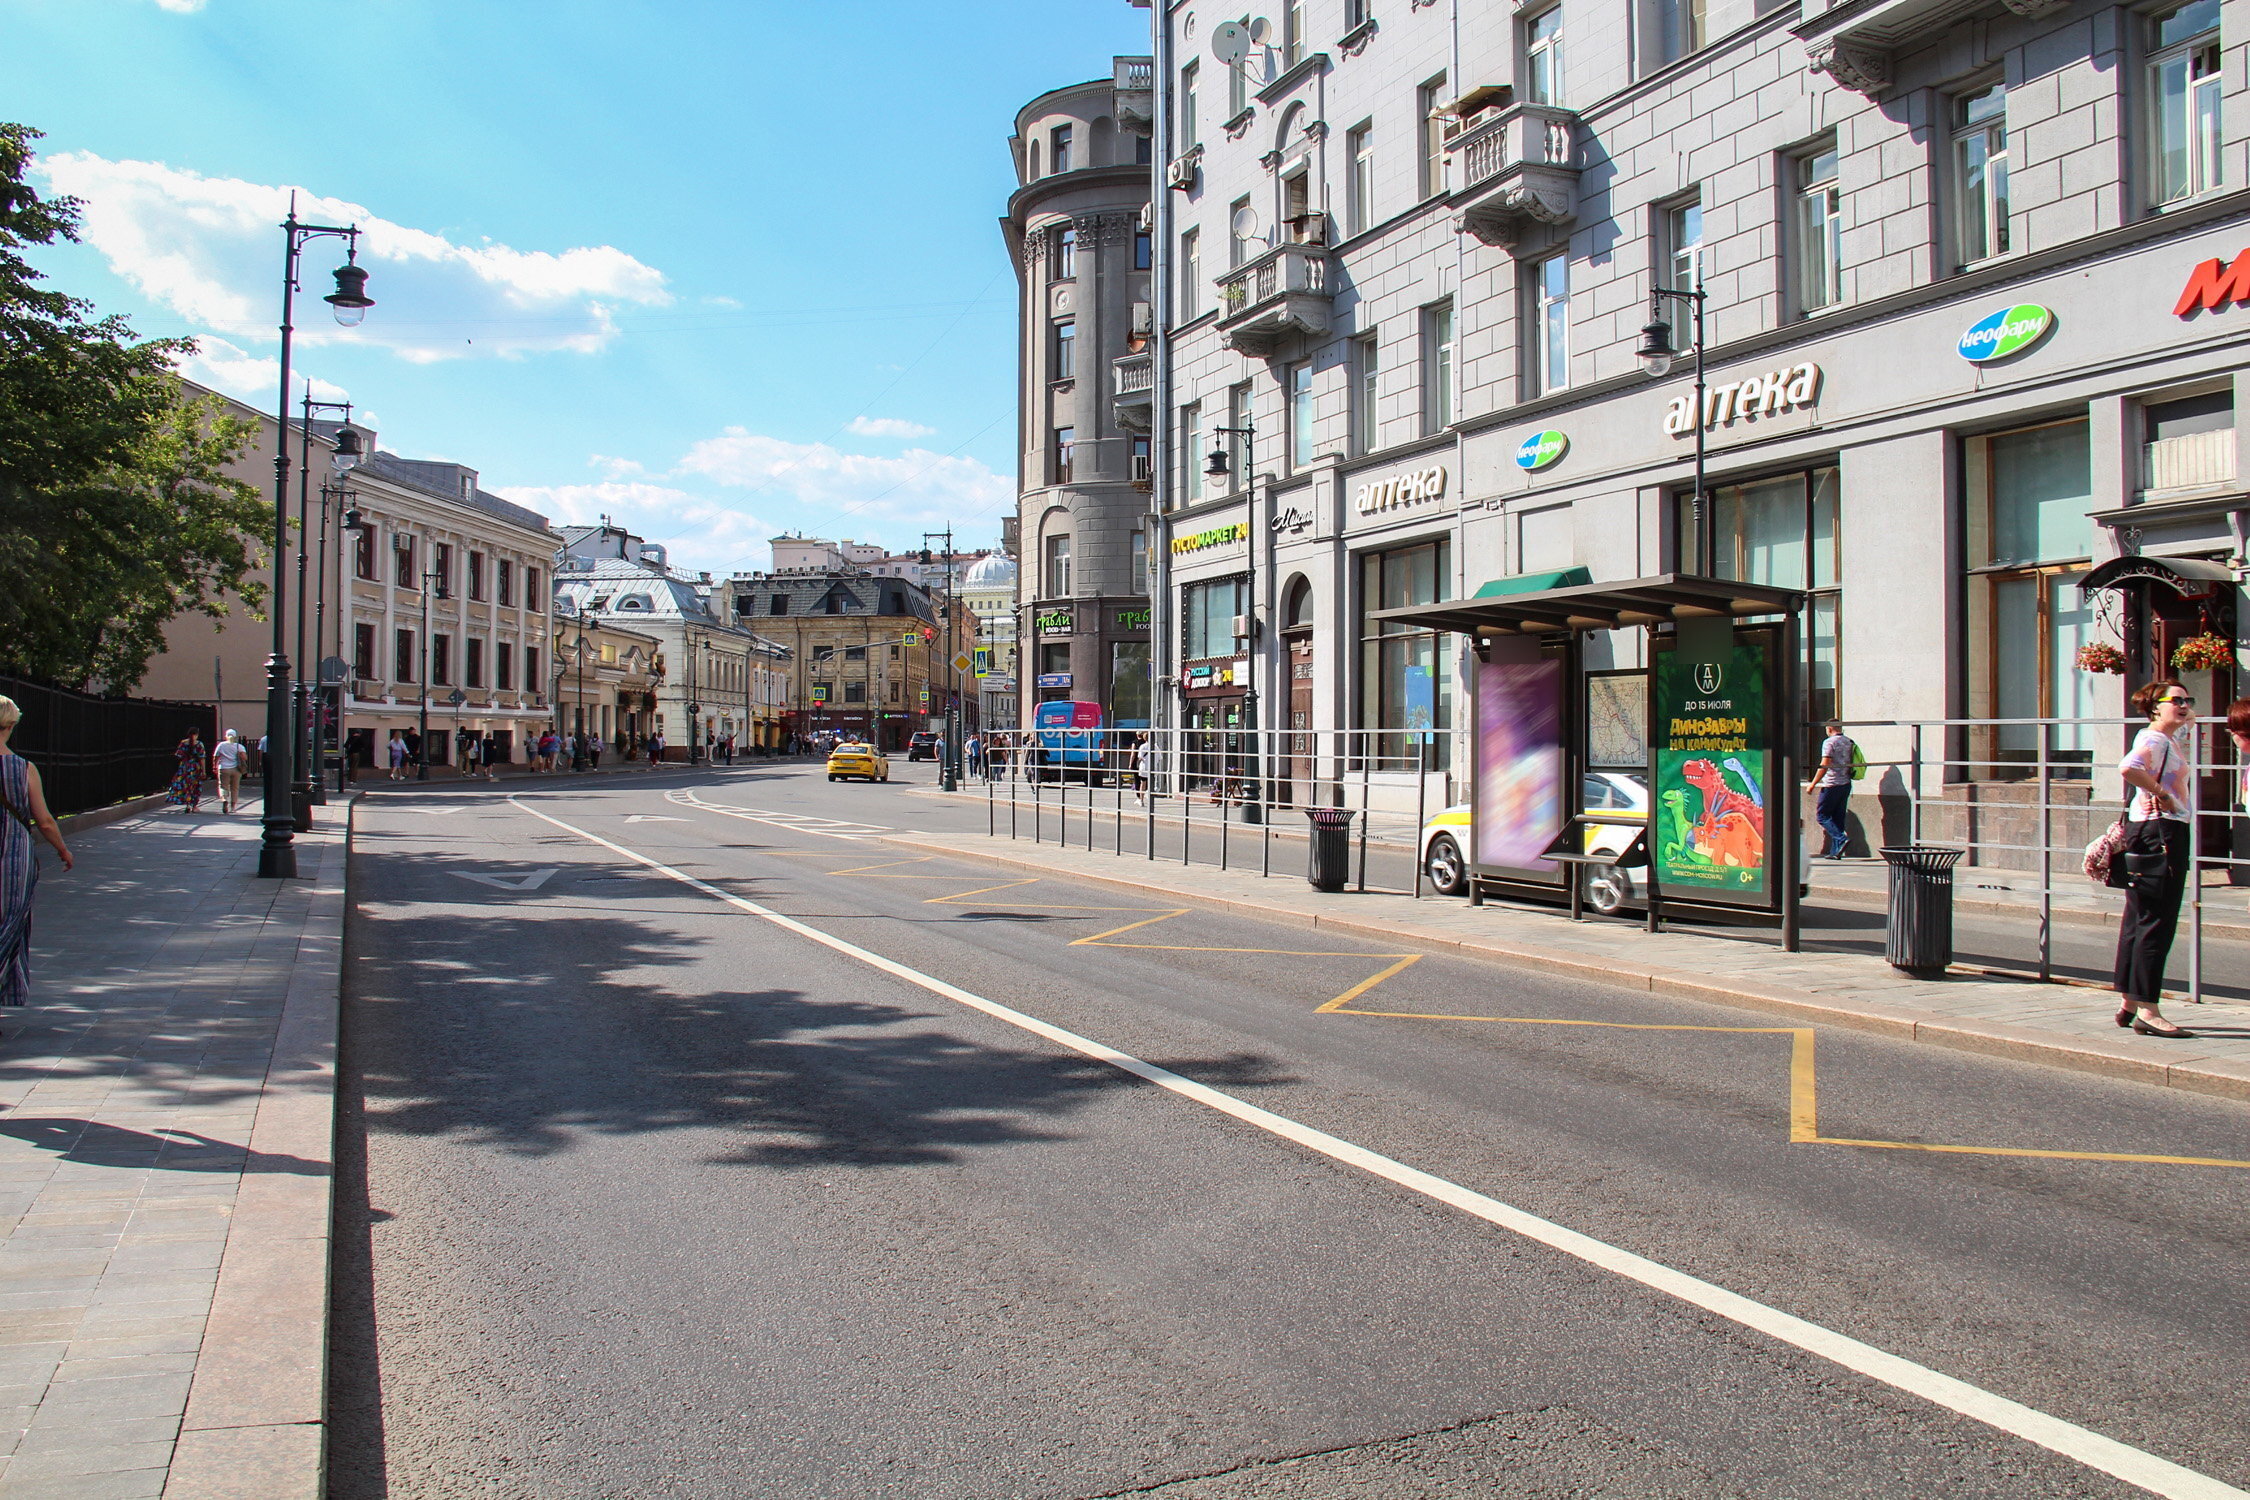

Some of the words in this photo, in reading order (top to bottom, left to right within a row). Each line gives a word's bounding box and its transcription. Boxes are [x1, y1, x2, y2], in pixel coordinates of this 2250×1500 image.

[1961, 315, 2044, 349] неофарм
[1663, 361, 1821, 435] аптека
[1354, 465, 1445, 512] аптека
[1172, 524, 1236, 553] ГУСТОМАРКЕТ
[1235, 522, 1248, 539] 24
[1036, 610, 1071, 634] грабли
[1684, 701, 1697, 711] ДО
[1698, 701, 1707, 710] 15
[1707, 700, 1731, 710] ИЮЛЯ
[1670, 717, 1746, 736] ДИНОЗАВРЫ
[1669, 738, 1685, 751] НА
[1686, 736, 1747, 752] КАНИКУЛАХ
[1739, 871, 1754, 883] 0+
